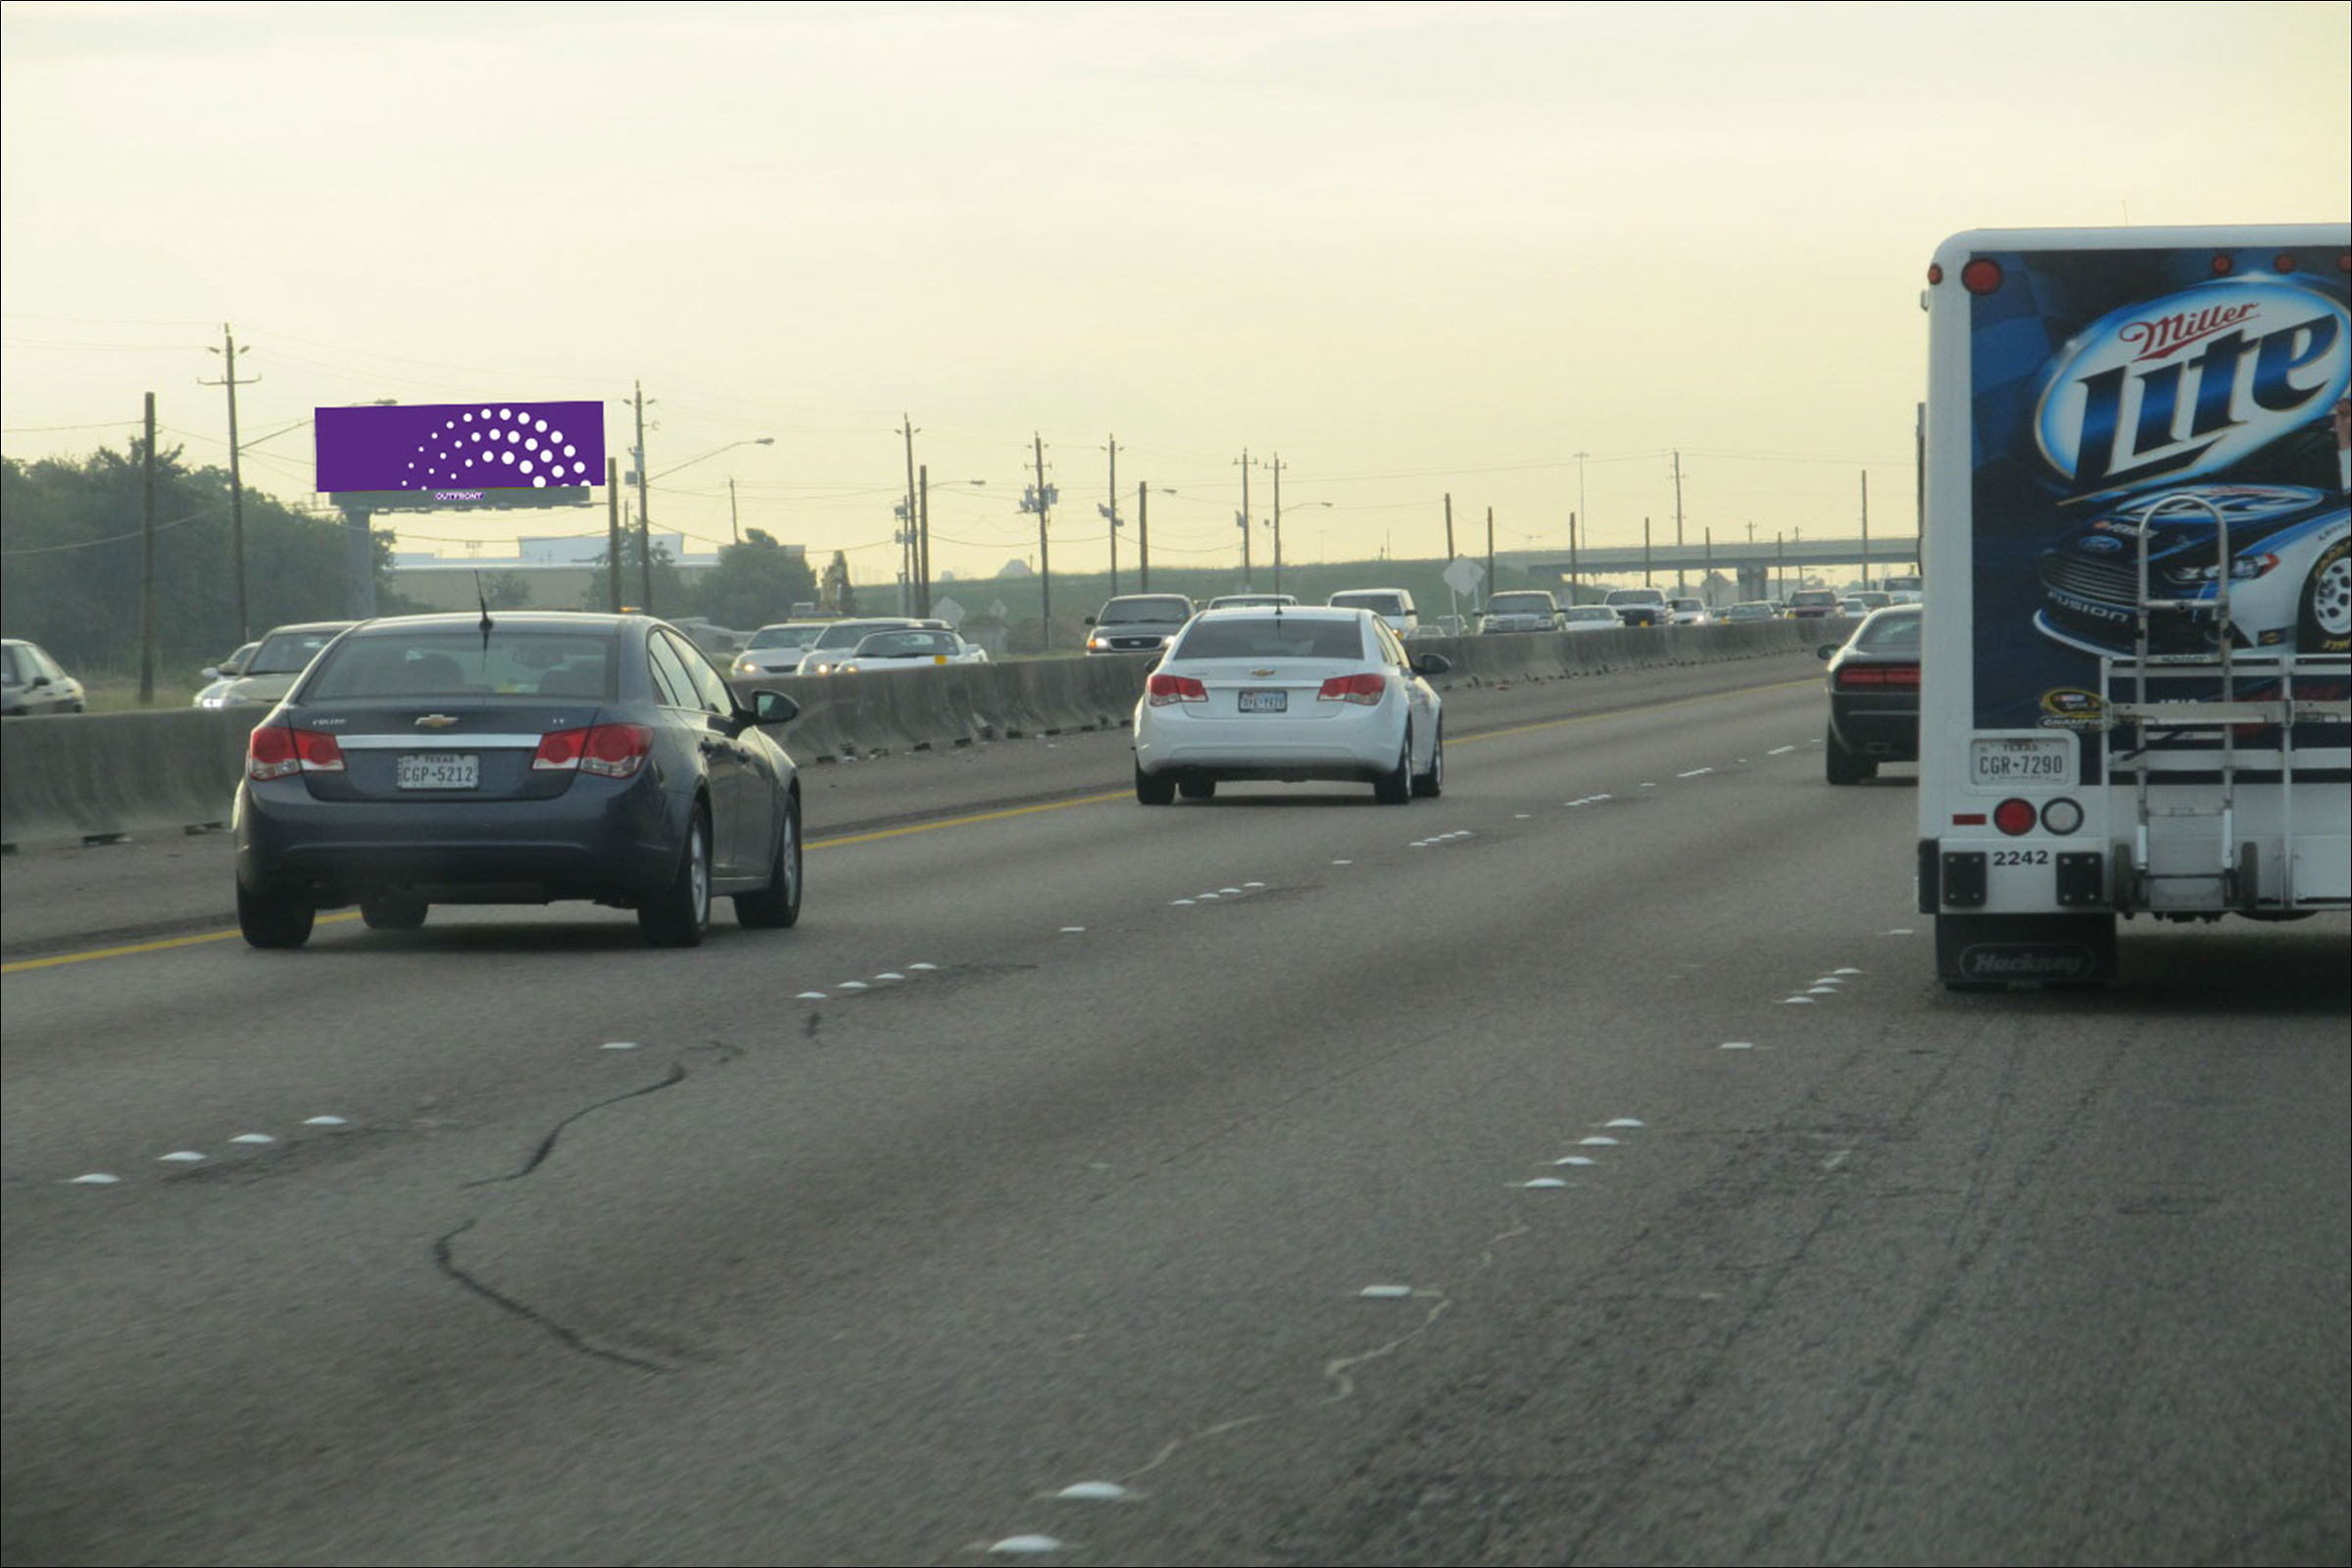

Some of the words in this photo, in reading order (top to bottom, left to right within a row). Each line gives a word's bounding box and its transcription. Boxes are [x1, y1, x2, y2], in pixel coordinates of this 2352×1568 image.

[2119, 302, 2262, 363] Miller
[2064, 313, 2338, 498] Lite
[2003, 743, 2038, 752] TEXAS
[1993, 851, 2049, 866] 2242
[1973, 953, 2082, 976] Hackney
